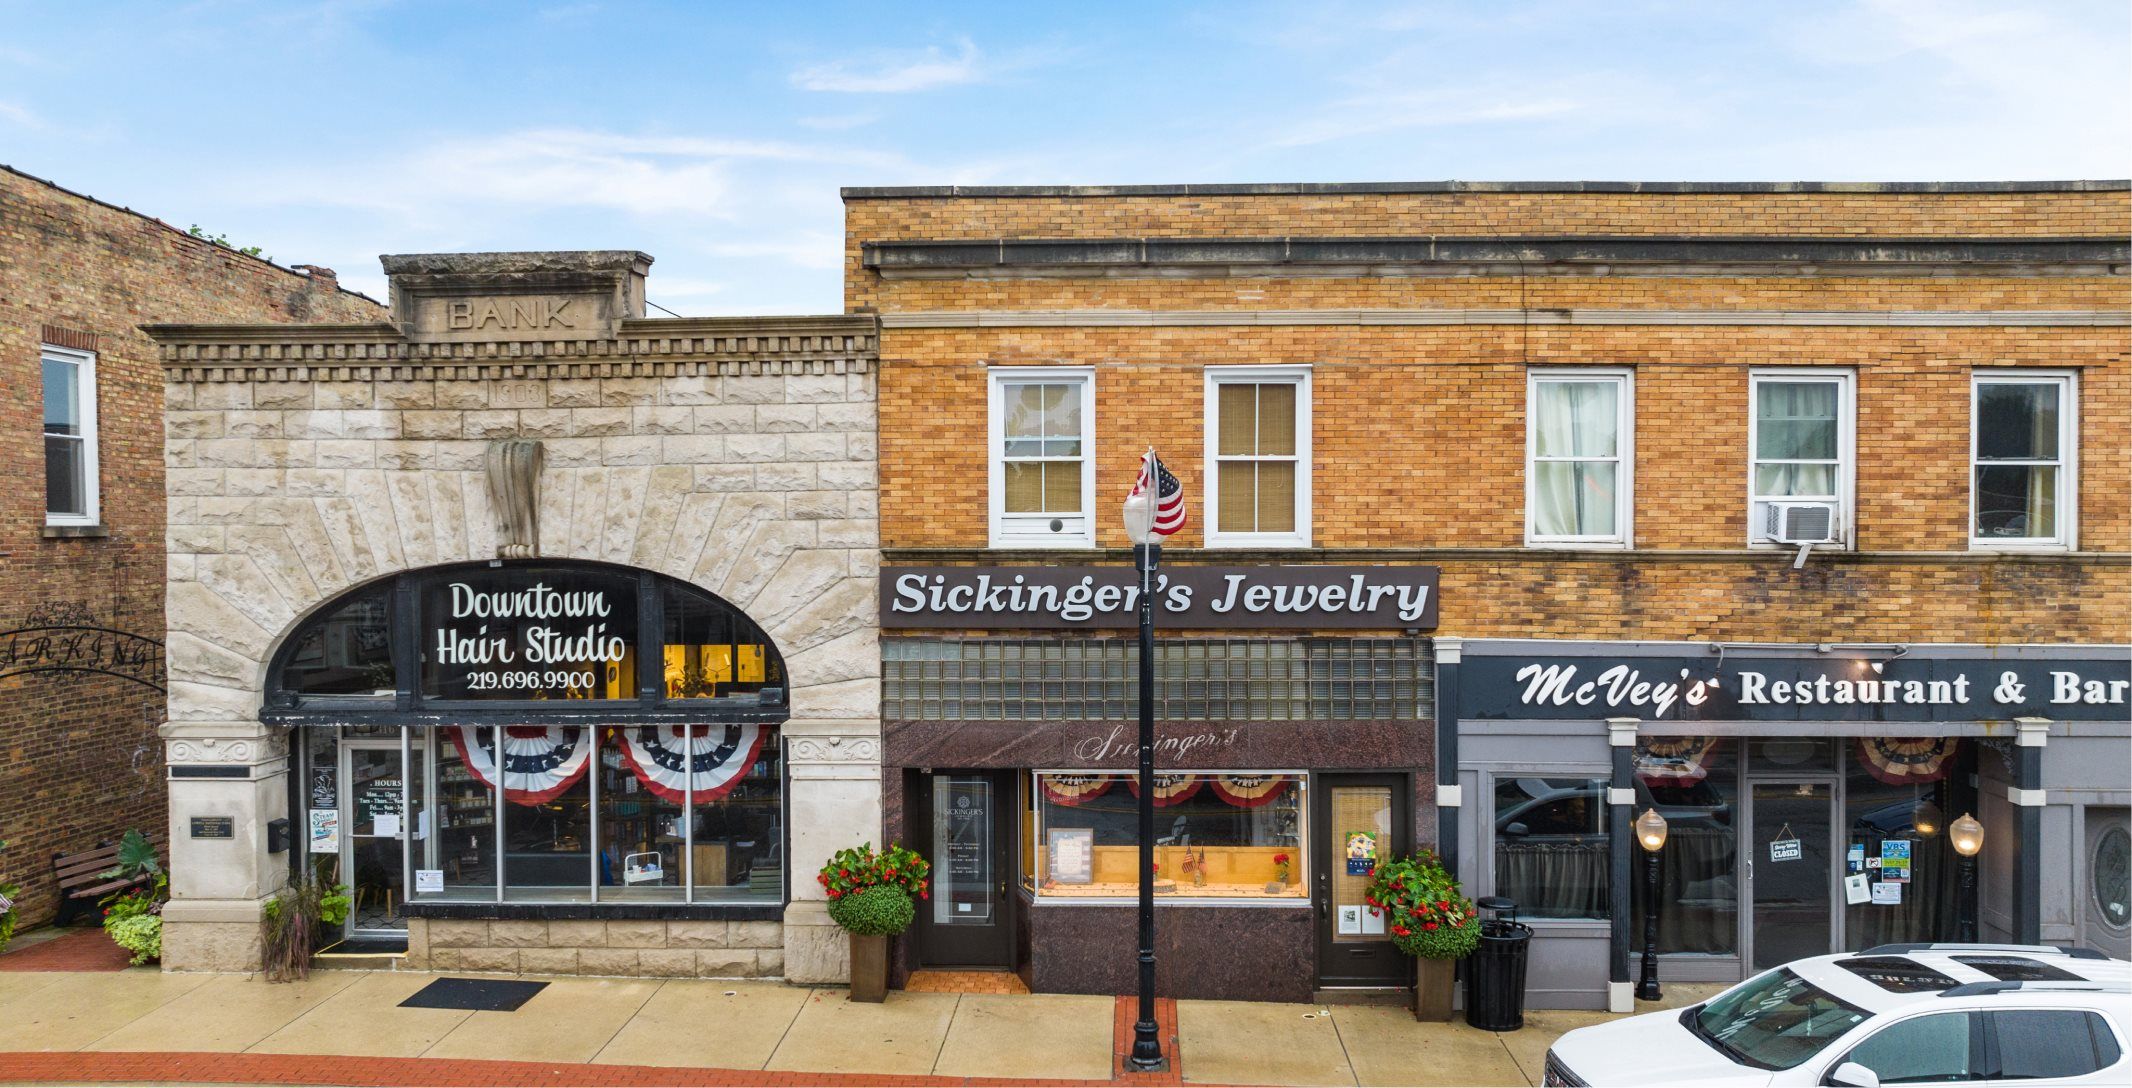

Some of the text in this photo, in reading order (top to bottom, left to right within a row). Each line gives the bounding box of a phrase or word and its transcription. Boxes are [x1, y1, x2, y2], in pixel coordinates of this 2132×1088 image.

[447, 299, 574, 330] BANK
[450, 582, 611, 619] Downtown
[891, 573, 1430, 622] Sickinger's Jewelry
[437, 623, 625, 665] Hair Studio
[467, 671, 596, 692] 219.696.9900
[1515, 662, 2130, 718] McVey's Restaurant & Bar
[374, 779, 402, 787] HOURS
[944, 808, 984, 817] SICKINGER'S
[1774, 849, 1799, 858] CLOSED
[1886, 843, 1906, 851] VBS
